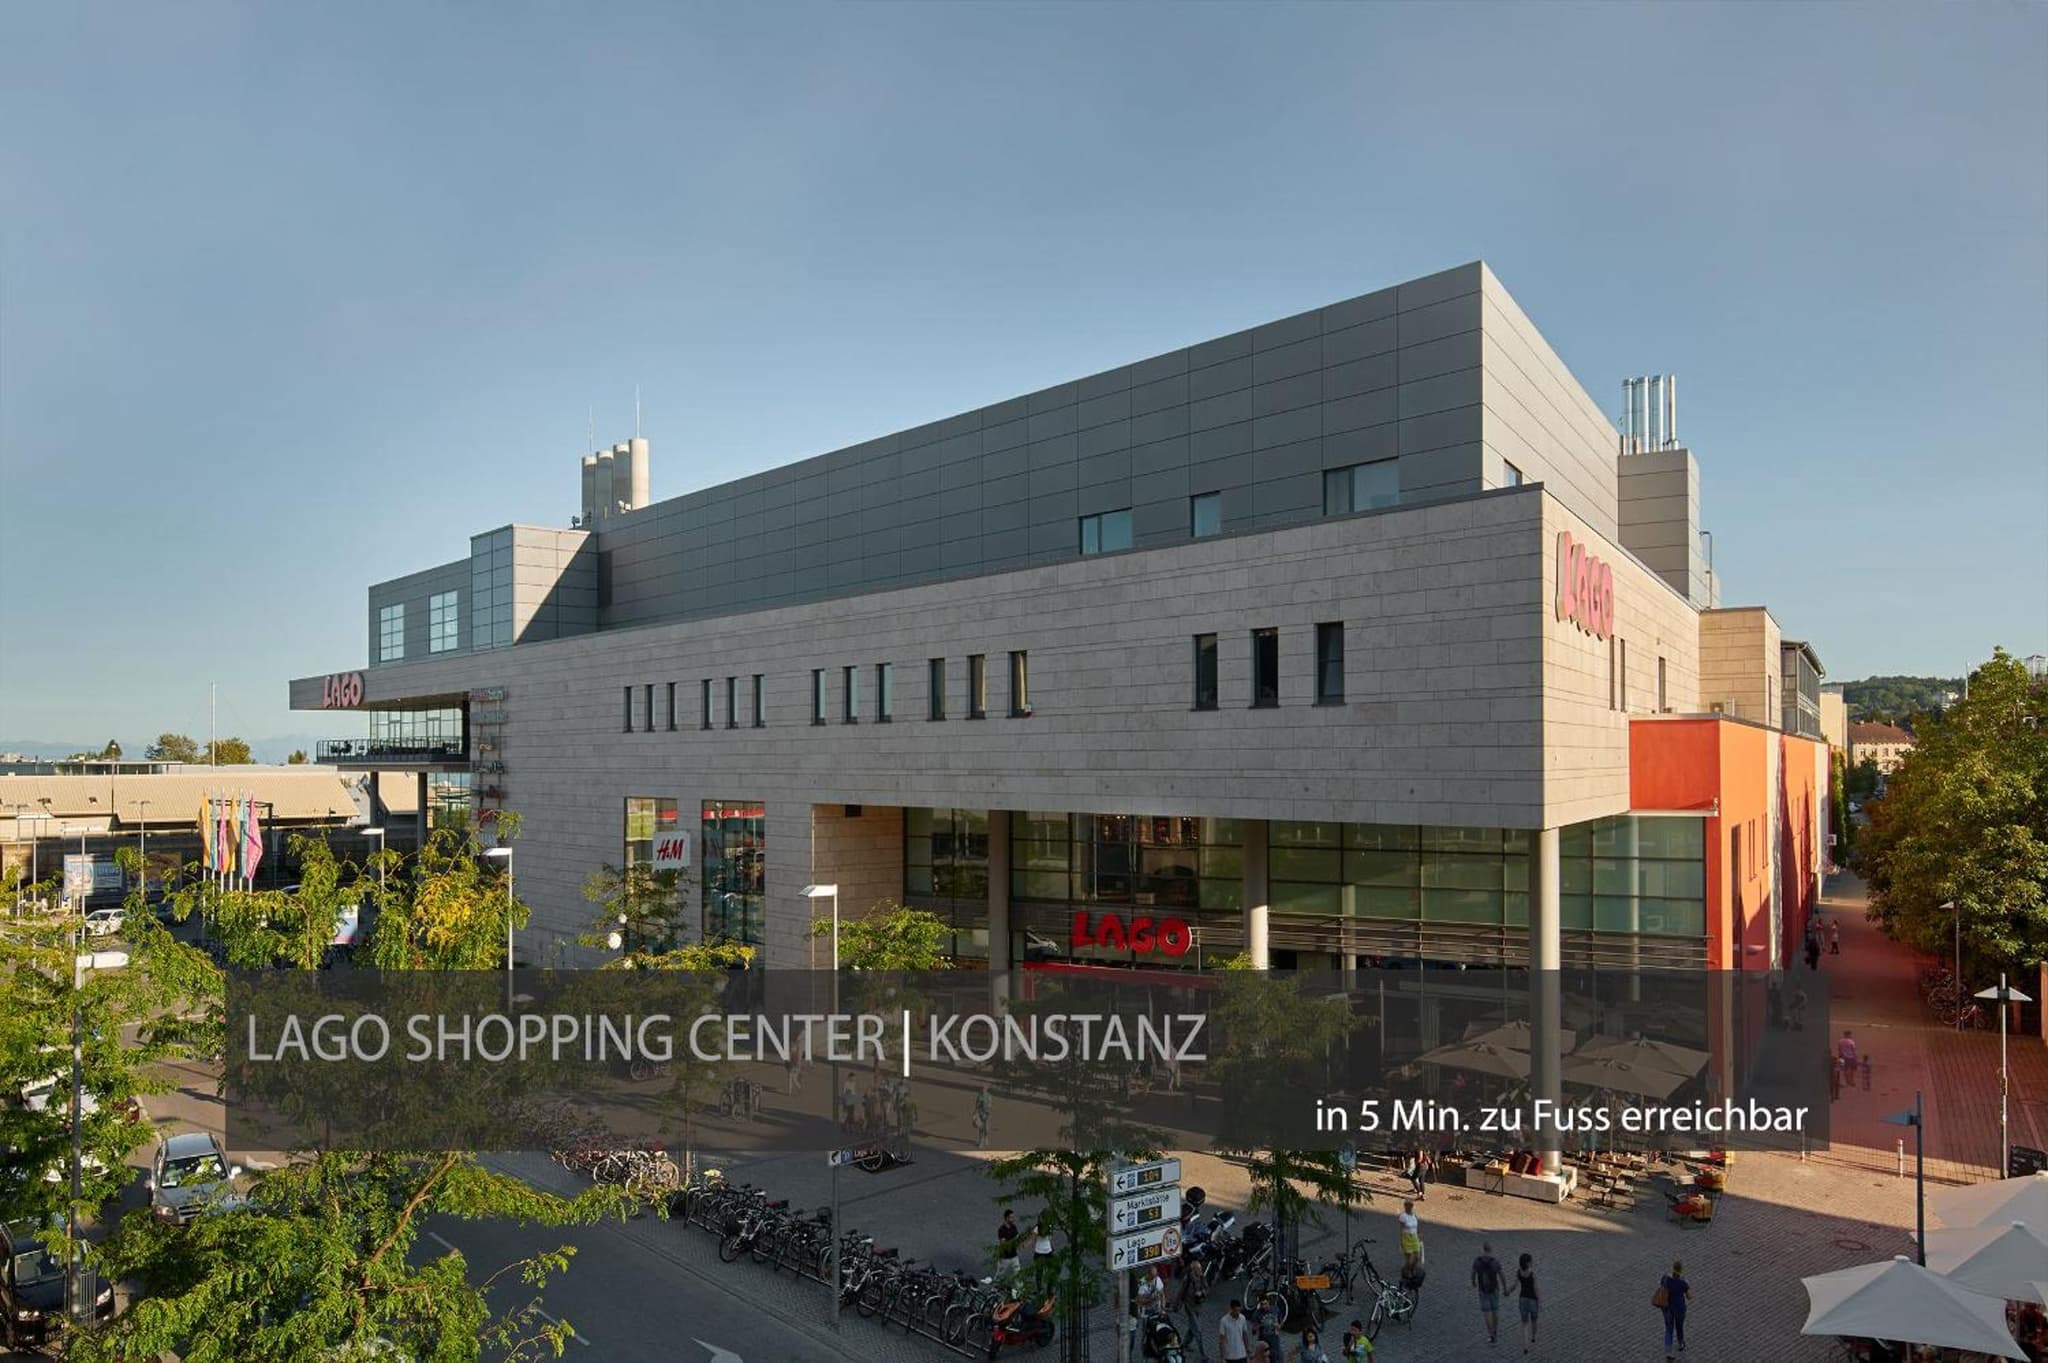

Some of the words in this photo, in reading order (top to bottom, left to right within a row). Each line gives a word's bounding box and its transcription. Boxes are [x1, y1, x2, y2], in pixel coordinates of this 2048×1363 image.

[1557, 530, 1614, 640] LAGO
[322, 671, 365, 709] LAGO
[657, 838, 684, 861] H&M
[1072, 911, 1192, 957] LAGO
